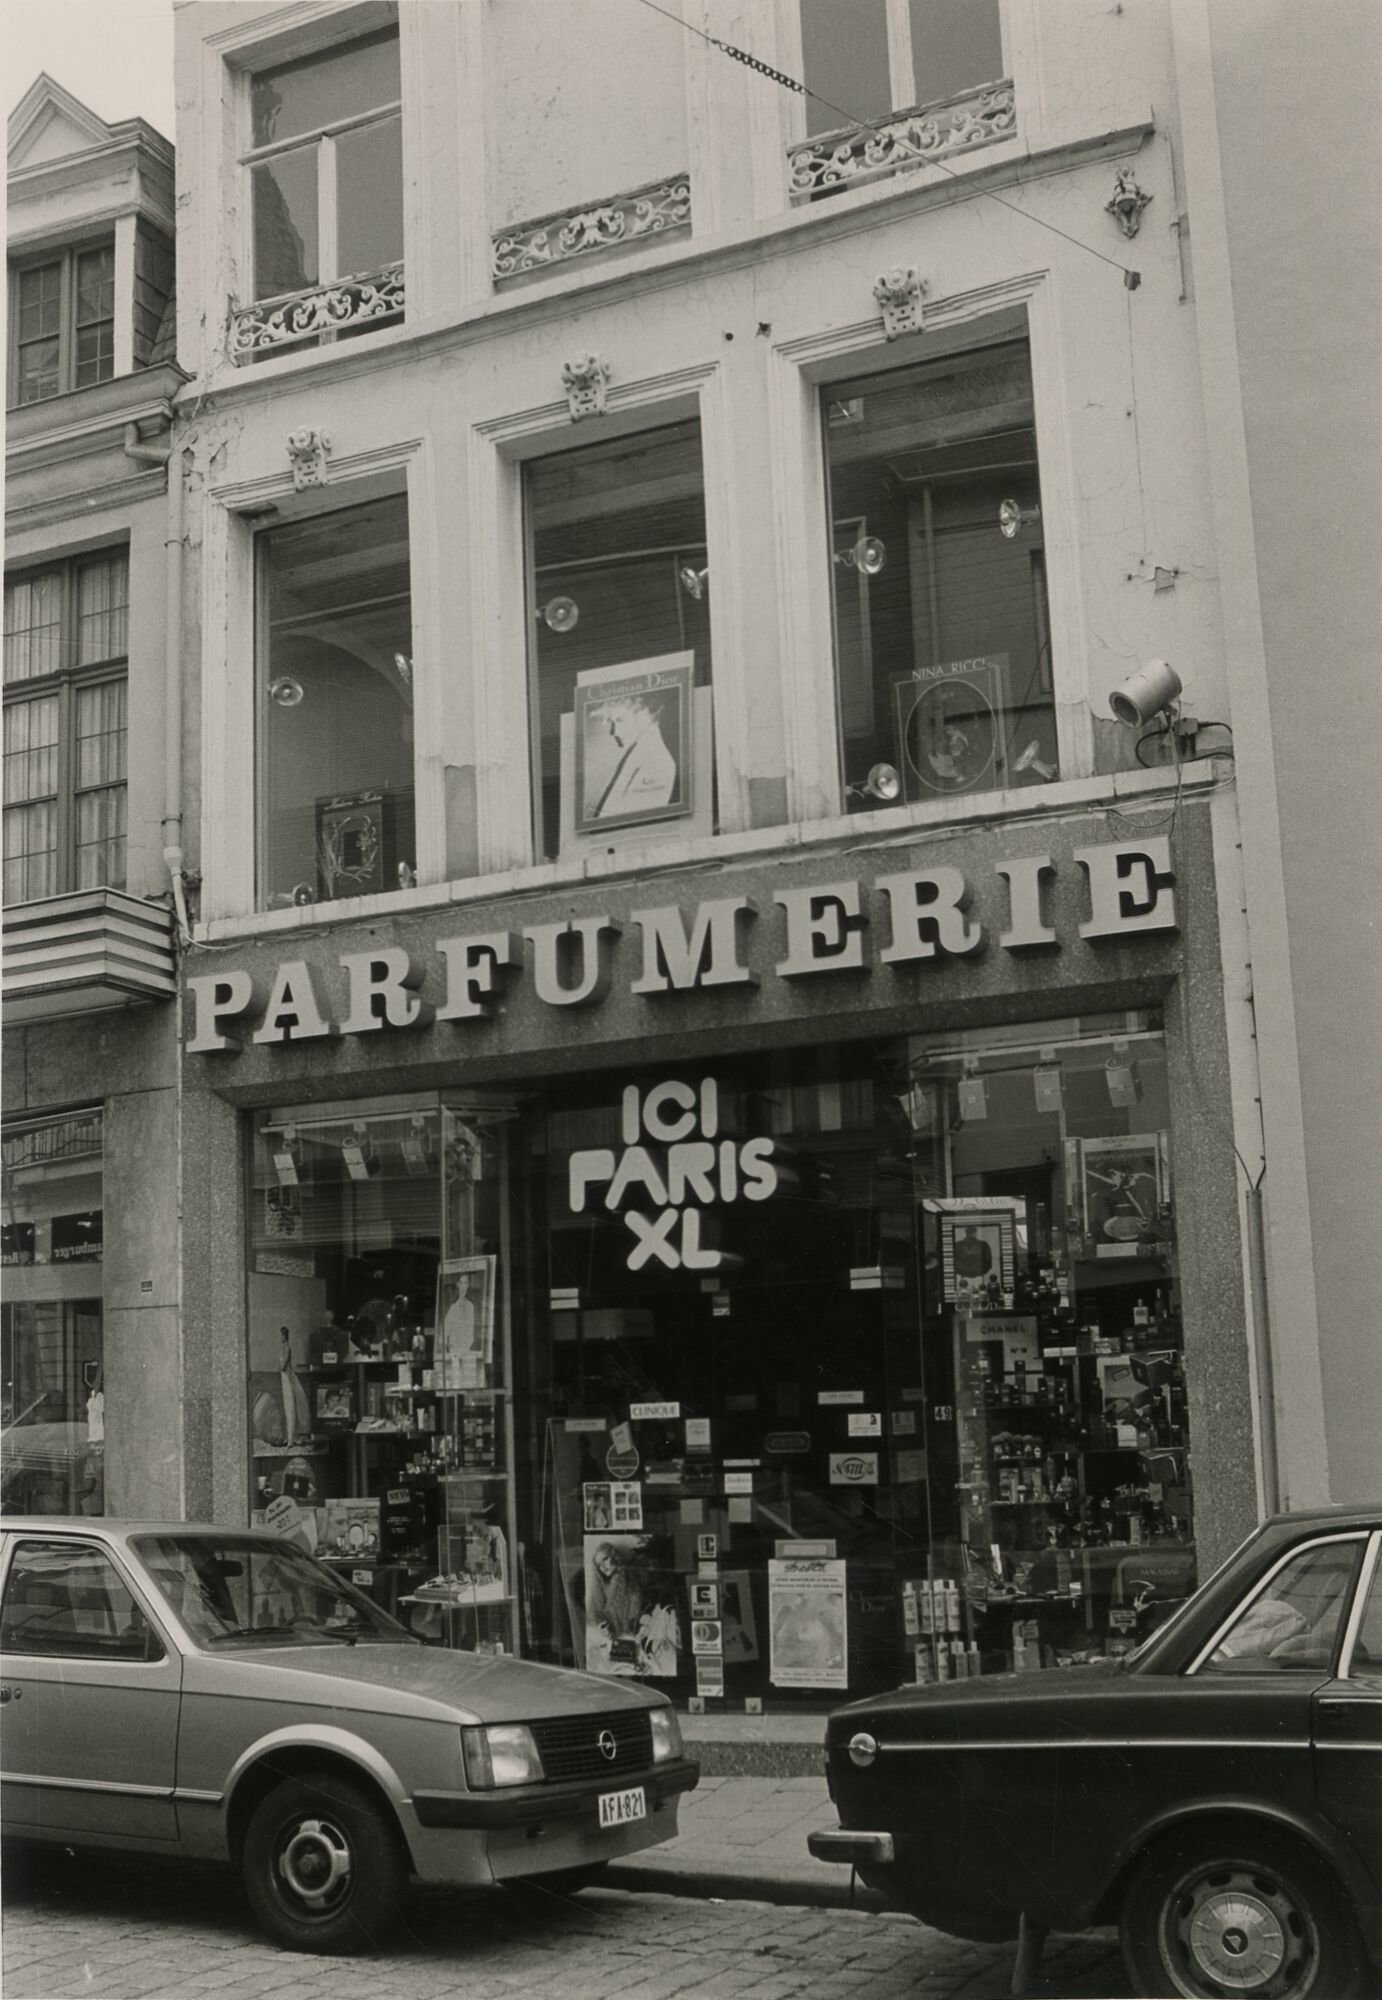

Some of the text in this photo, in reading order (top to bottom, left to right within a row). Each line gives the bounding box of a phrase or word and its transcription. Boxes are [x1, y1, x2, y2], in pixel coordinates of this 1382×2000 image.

[587, 673, 679, 700] Christian Dior
[911, 666, 944, 681] NINA
[184, 836, 1178, 1055] PARFUMERIE
[622, 1076, 718, 1146] ICI
[568, 1137, 778, 1213] PARIS
[624, 1207, 722, 1272] XL
[980, 1323, 1026, 1336] CHANEL
[632, 1404, 678, 1417] CLINIQUE
[935, 1406, 951, 1421] 49
